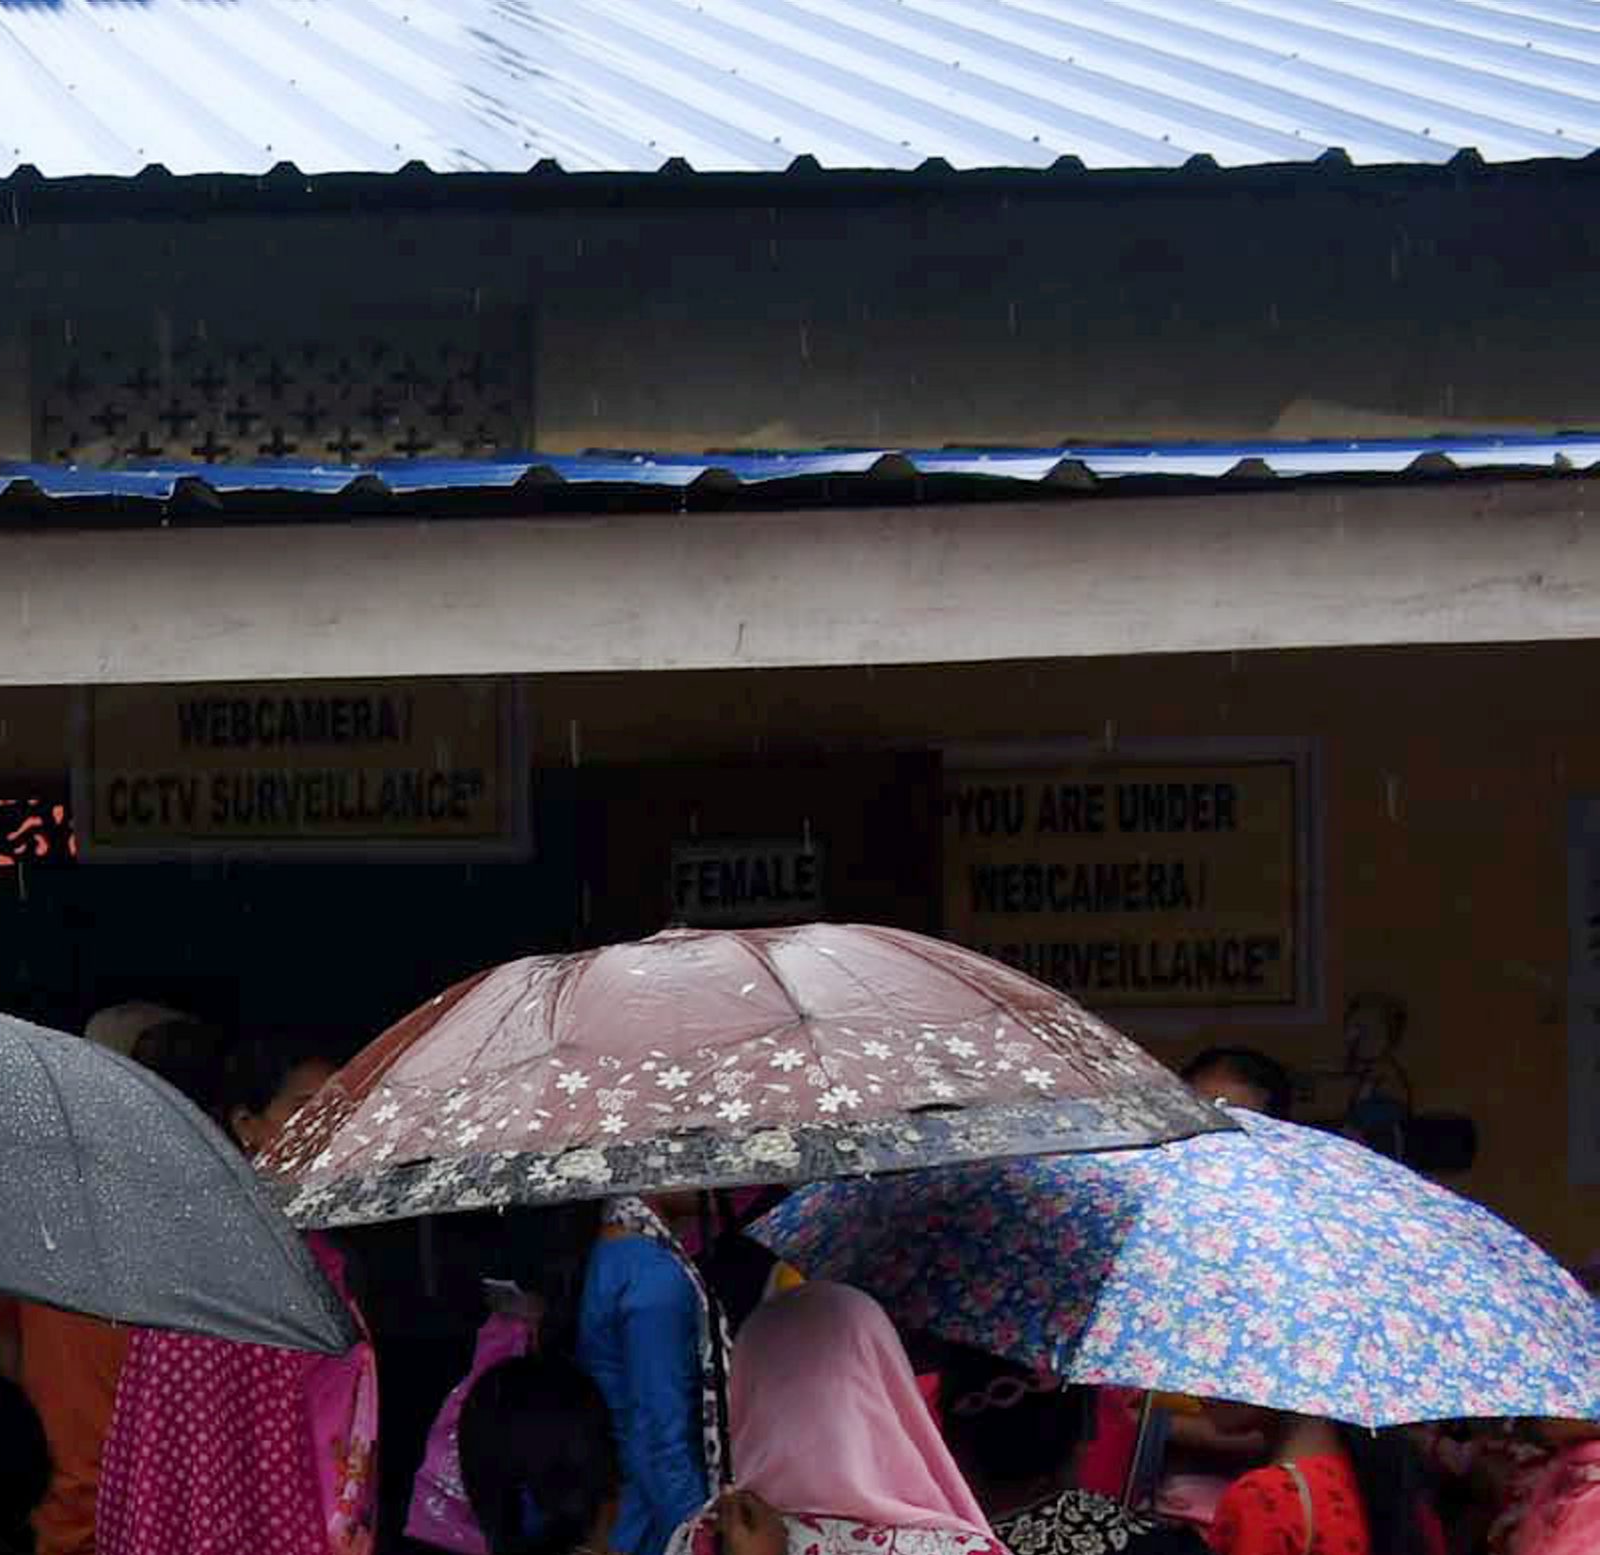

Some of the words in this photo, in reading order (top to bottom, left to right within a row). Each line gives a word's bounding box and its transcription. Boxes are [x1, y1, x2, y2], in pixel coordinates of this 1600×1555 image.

[109, 770, 197, 822] CCTV
[954, 784, 1025, 836] YOU
[1038, 784, 1105, 834] ARE
[1116, 783, 1236, 832] UNDER
[673, 855, 816, 907] FEMALE
